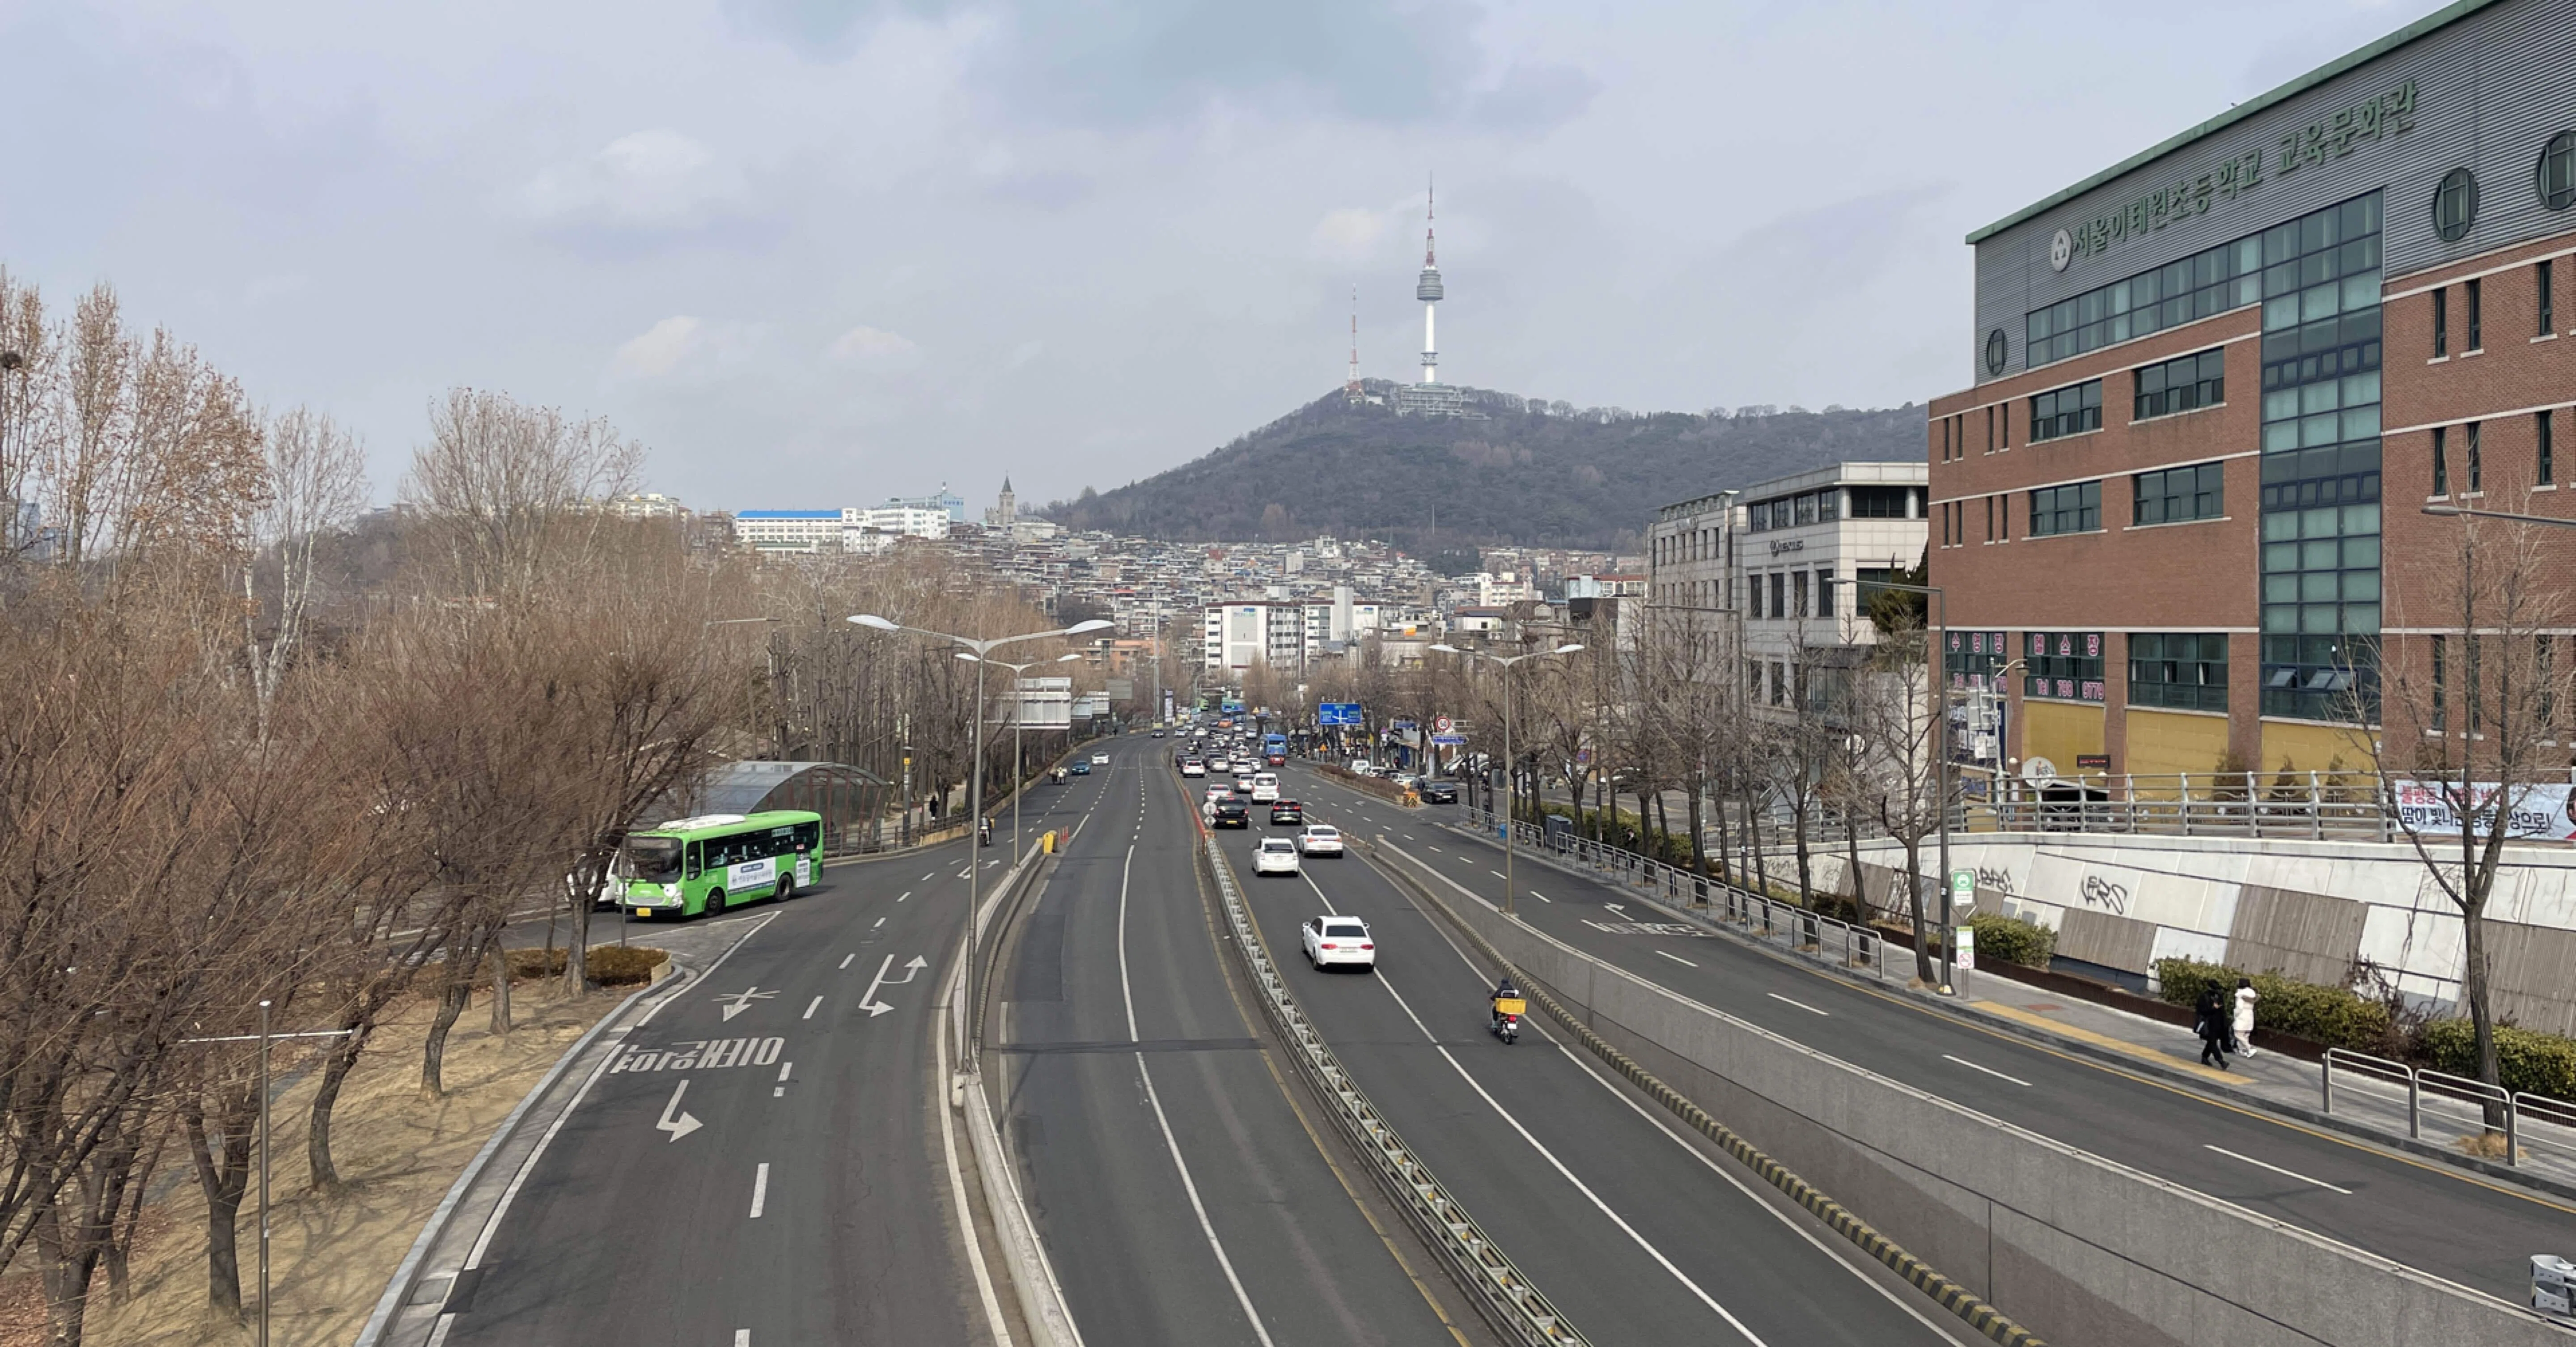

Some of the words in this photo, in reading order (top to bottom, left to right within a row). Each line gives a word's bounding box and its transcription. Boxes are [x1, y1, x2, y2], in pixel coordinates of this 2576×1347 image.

[2072, 148, 2263, 257] 서울이태원초등학교
[2276, 80, 2417, 174] 교육문화관
[2034, 634, 2100, 656] 헬스장
[609, 1037, 785, 1074] 이태원역
